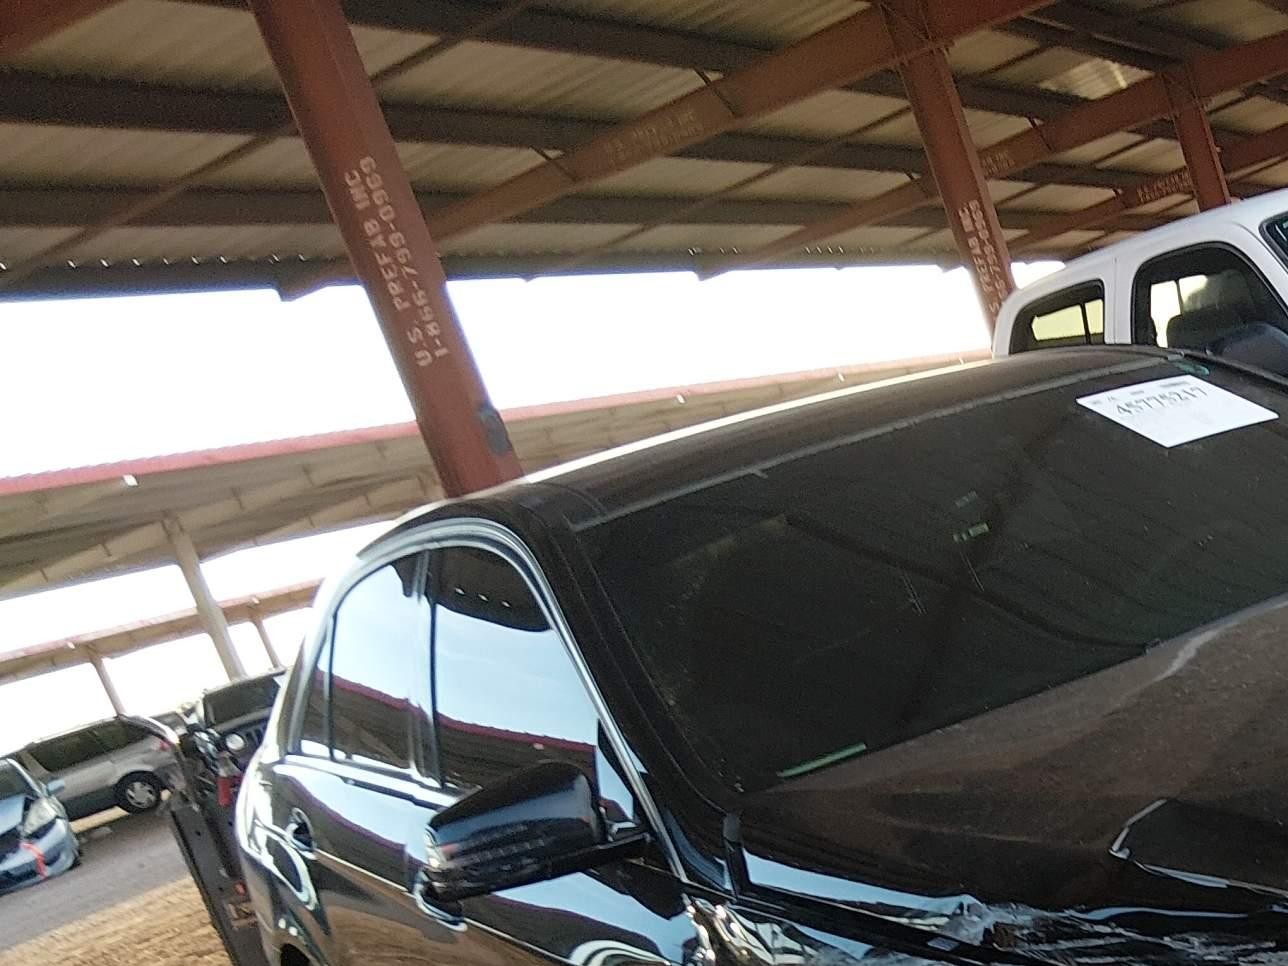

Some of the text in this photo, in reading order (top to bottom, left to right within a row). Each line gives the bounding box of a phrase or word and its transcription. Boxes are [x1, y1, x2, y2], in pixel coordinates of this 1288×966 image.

[343, 168, 371, 211] INC
[363, 218, 412, 311] PREFAB
[1116, 385, 1208, 416] 45775217
